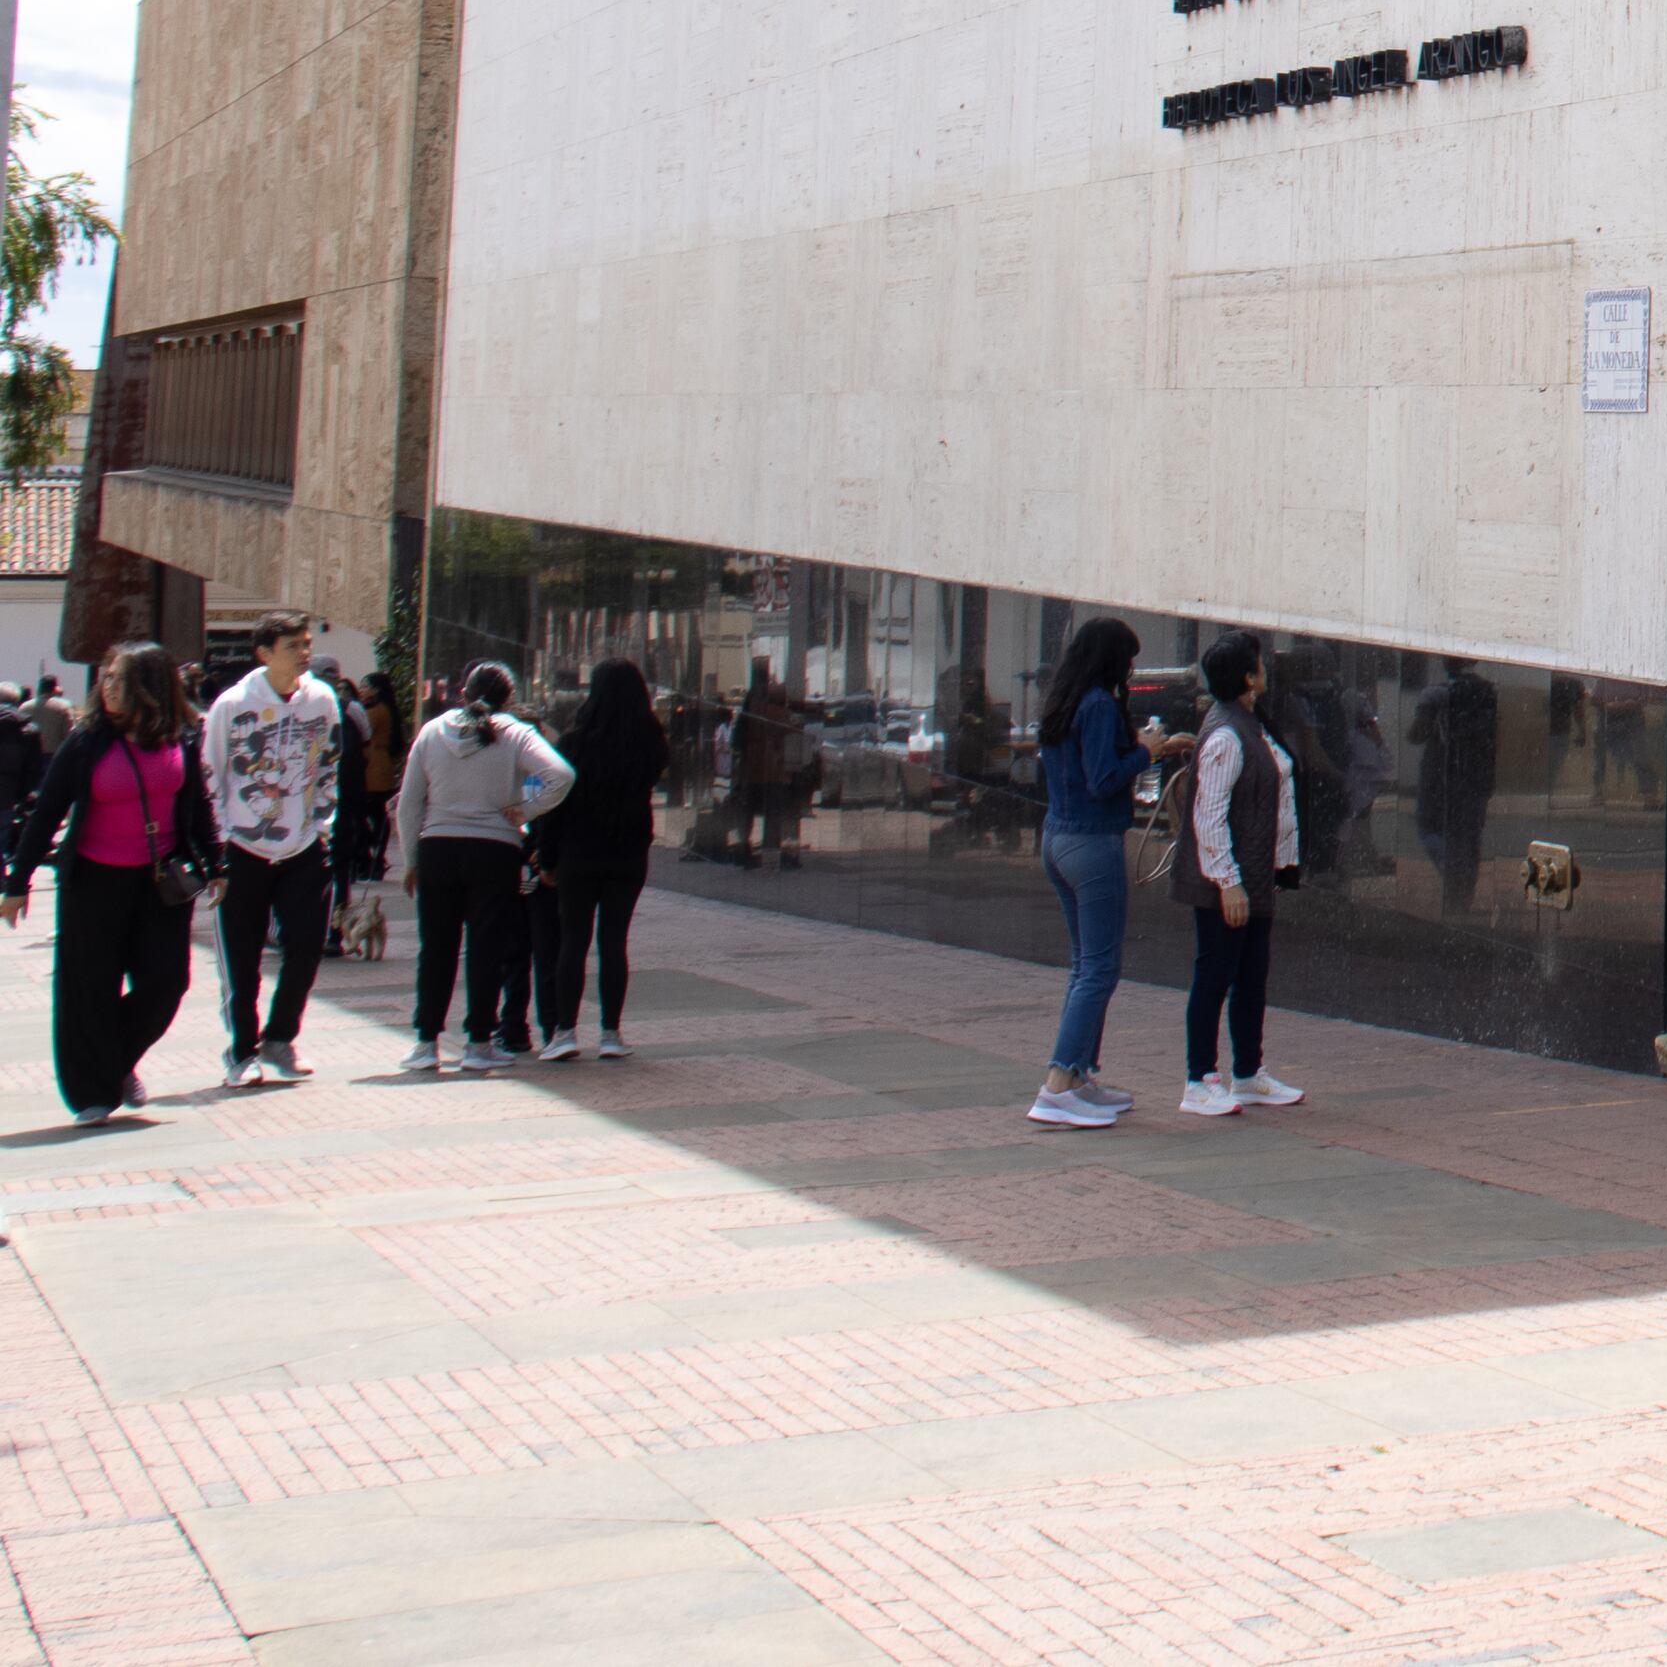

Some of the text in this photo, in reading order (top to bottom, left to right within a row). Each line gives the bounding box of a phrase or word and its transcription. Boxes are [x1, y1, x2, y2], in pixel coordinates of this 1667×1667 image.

[1162, 77, 1277, 129] BIBLIOTECA
[1416, 24, 1528, 80] ARANGO
[1603, 303, 1629, 322] CALLE
[1609, 331, 1621, 344] DE
[1589, 350, 1641, 370] LA MONEDA
